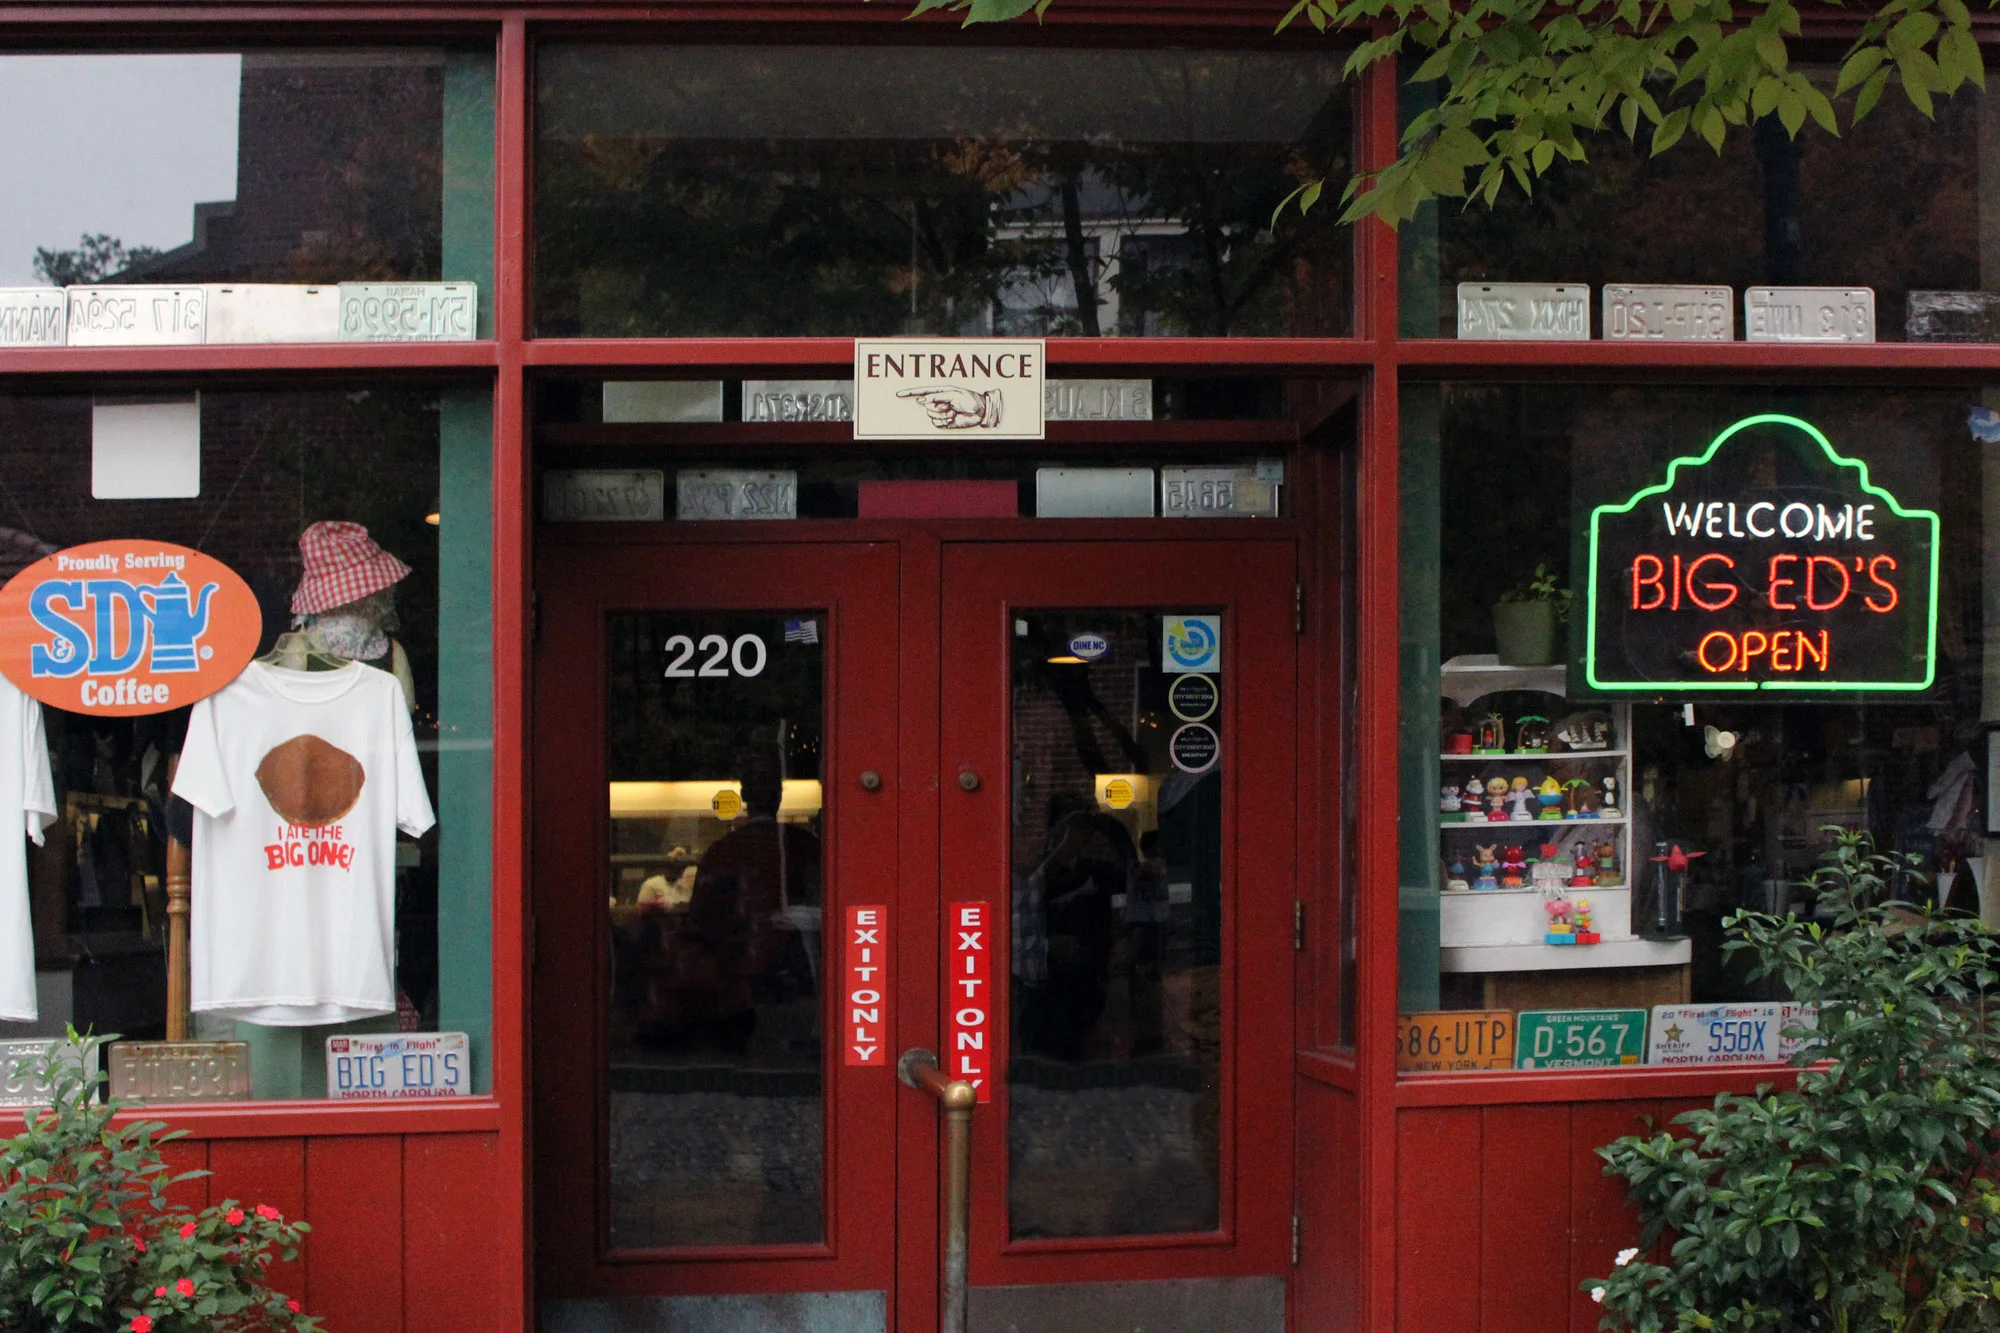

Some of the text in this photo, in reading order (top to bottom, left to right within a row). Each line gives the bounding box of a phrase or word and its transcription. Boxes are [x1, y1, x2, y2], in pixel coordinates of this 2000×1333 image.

[866, 352, 1033, 380] ENTRANCE
[1663, 501, 1876, 541] WELCOME
[57, 552, 185, 574] Proudly Serving
[1631, 553, 1899, 613] BIG ED'S
[664, 632, 767, 679] 220
[1073, 640, 1104, 650] DINE NC
[1697, 629, 1830, 673] OPEN
[80, 678, 170, 707] Coffee
[278, 823, 342, 840] I ATE THE
[264, 841, 356, 873] BIG ONE!
[957, 908, 983, 998] EXIT
[851, 910, 880, 1061] EXIT ONLY
[406, 1040, 437, 1050] Flight
[337, 1053, 459, 1089] BIG ED'S
[1448, 1059, 1478, 1070] YORK
[1544, 1057, 1614, 1069] VERMONT
